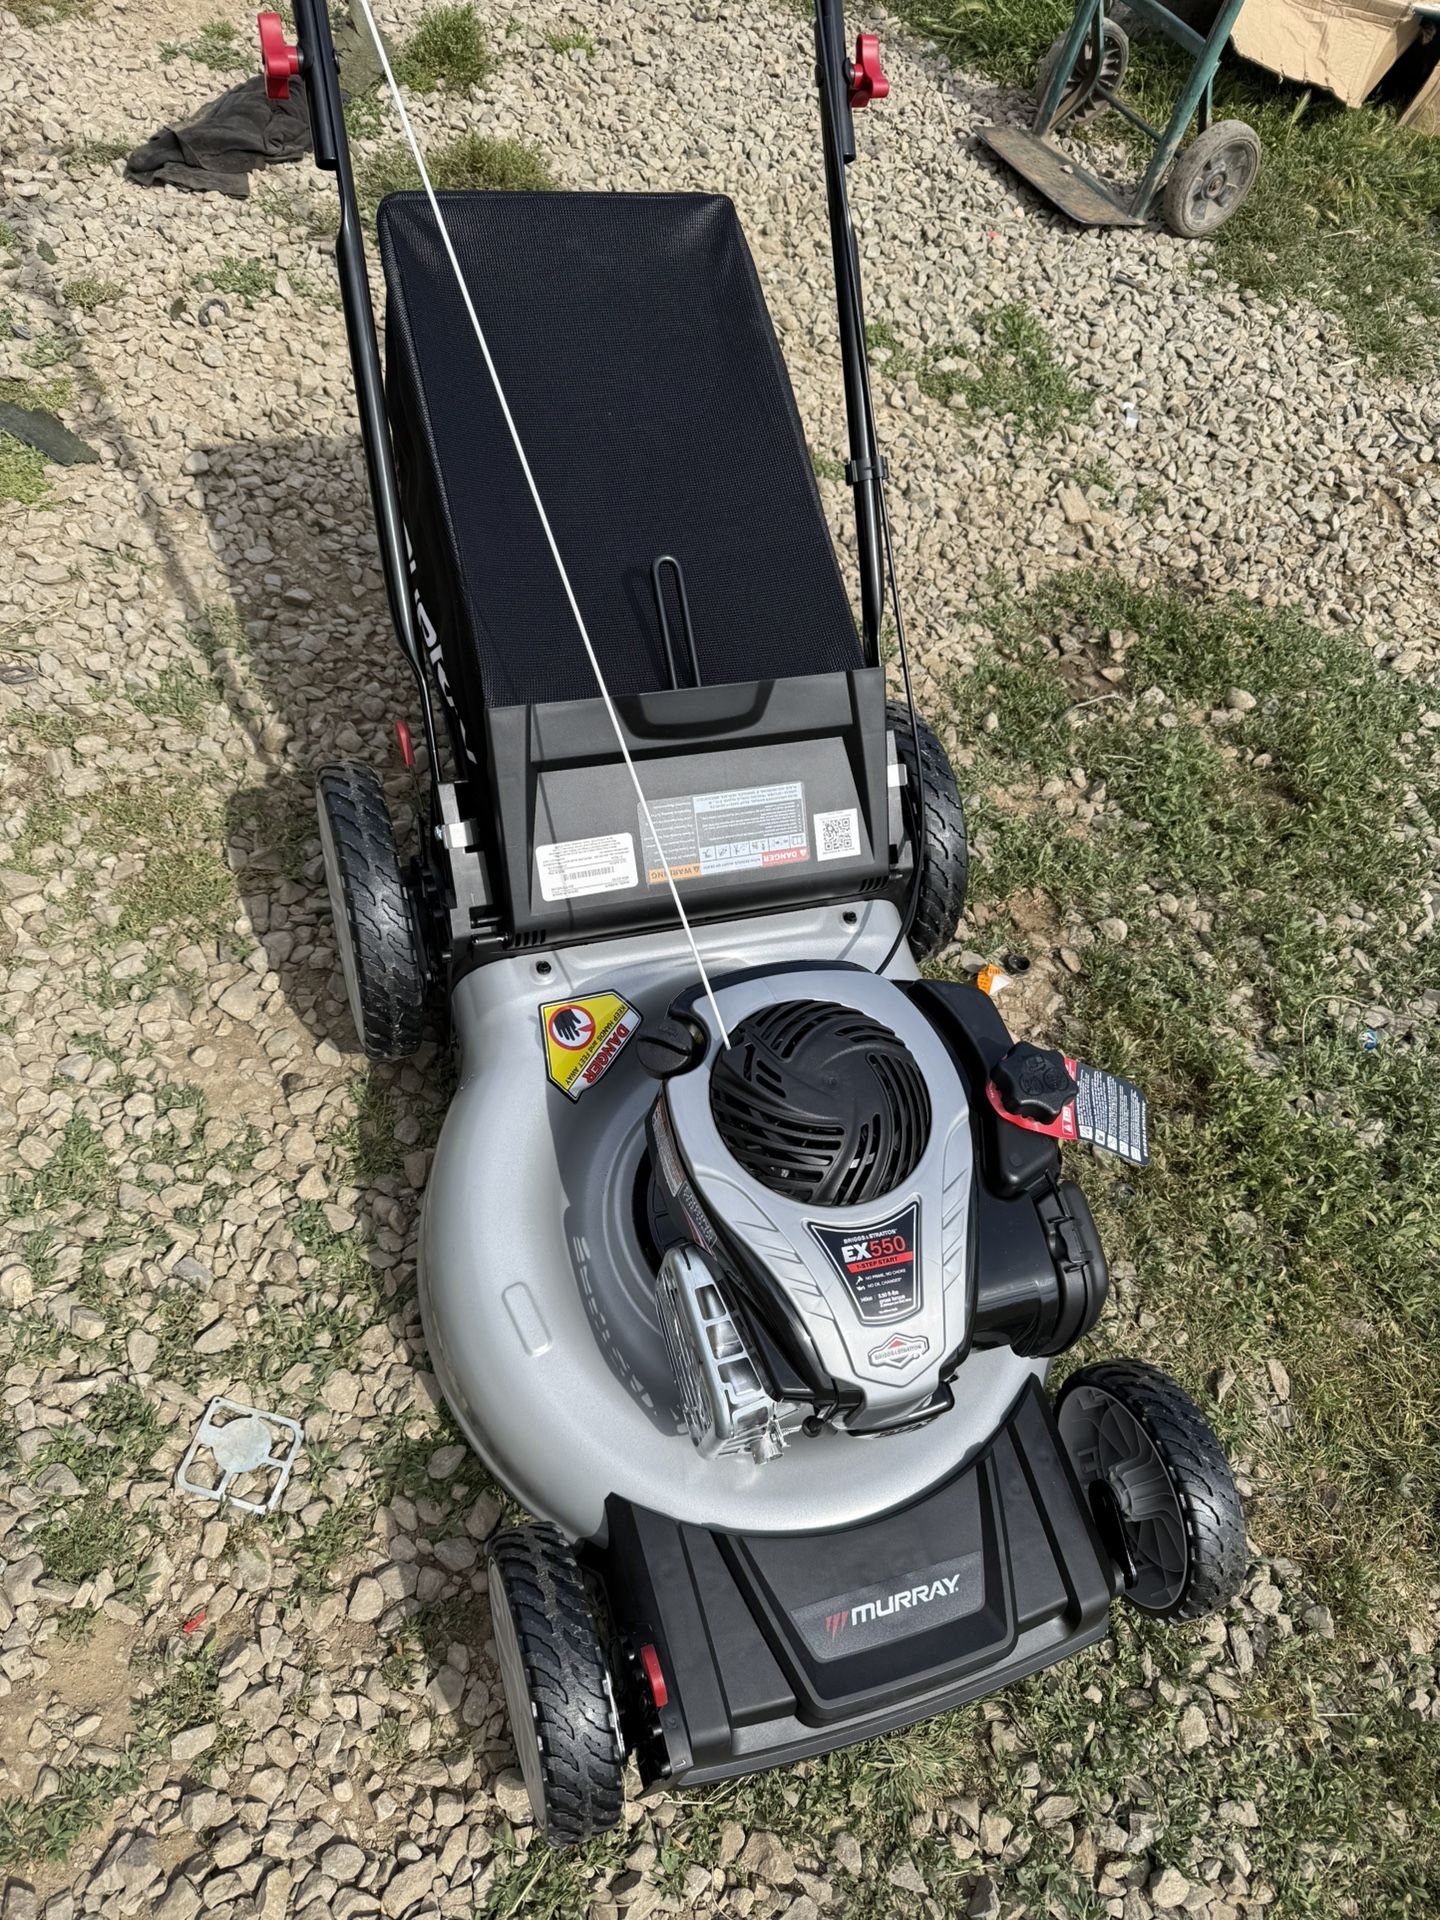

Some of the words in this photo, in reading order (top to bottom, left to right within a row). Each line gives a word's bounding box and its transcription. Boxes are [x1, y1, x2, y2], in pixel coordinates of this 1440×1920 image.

[763, 851, 798, 862] DANGER
[651, 868, 692, 879] WARNG
[612, 1004, 626, 1021] KEEP
[597, 1019, 614, 1042] HANDS
[578, 1051, 592, 1068] FEET
[582, 1023, 630, 1084] DANGER
[565, 1066, 579, 1085] AWAY
[841, 1235, 906, 1263] EX550
[851, 1573, 961, 1626] MURRAY
